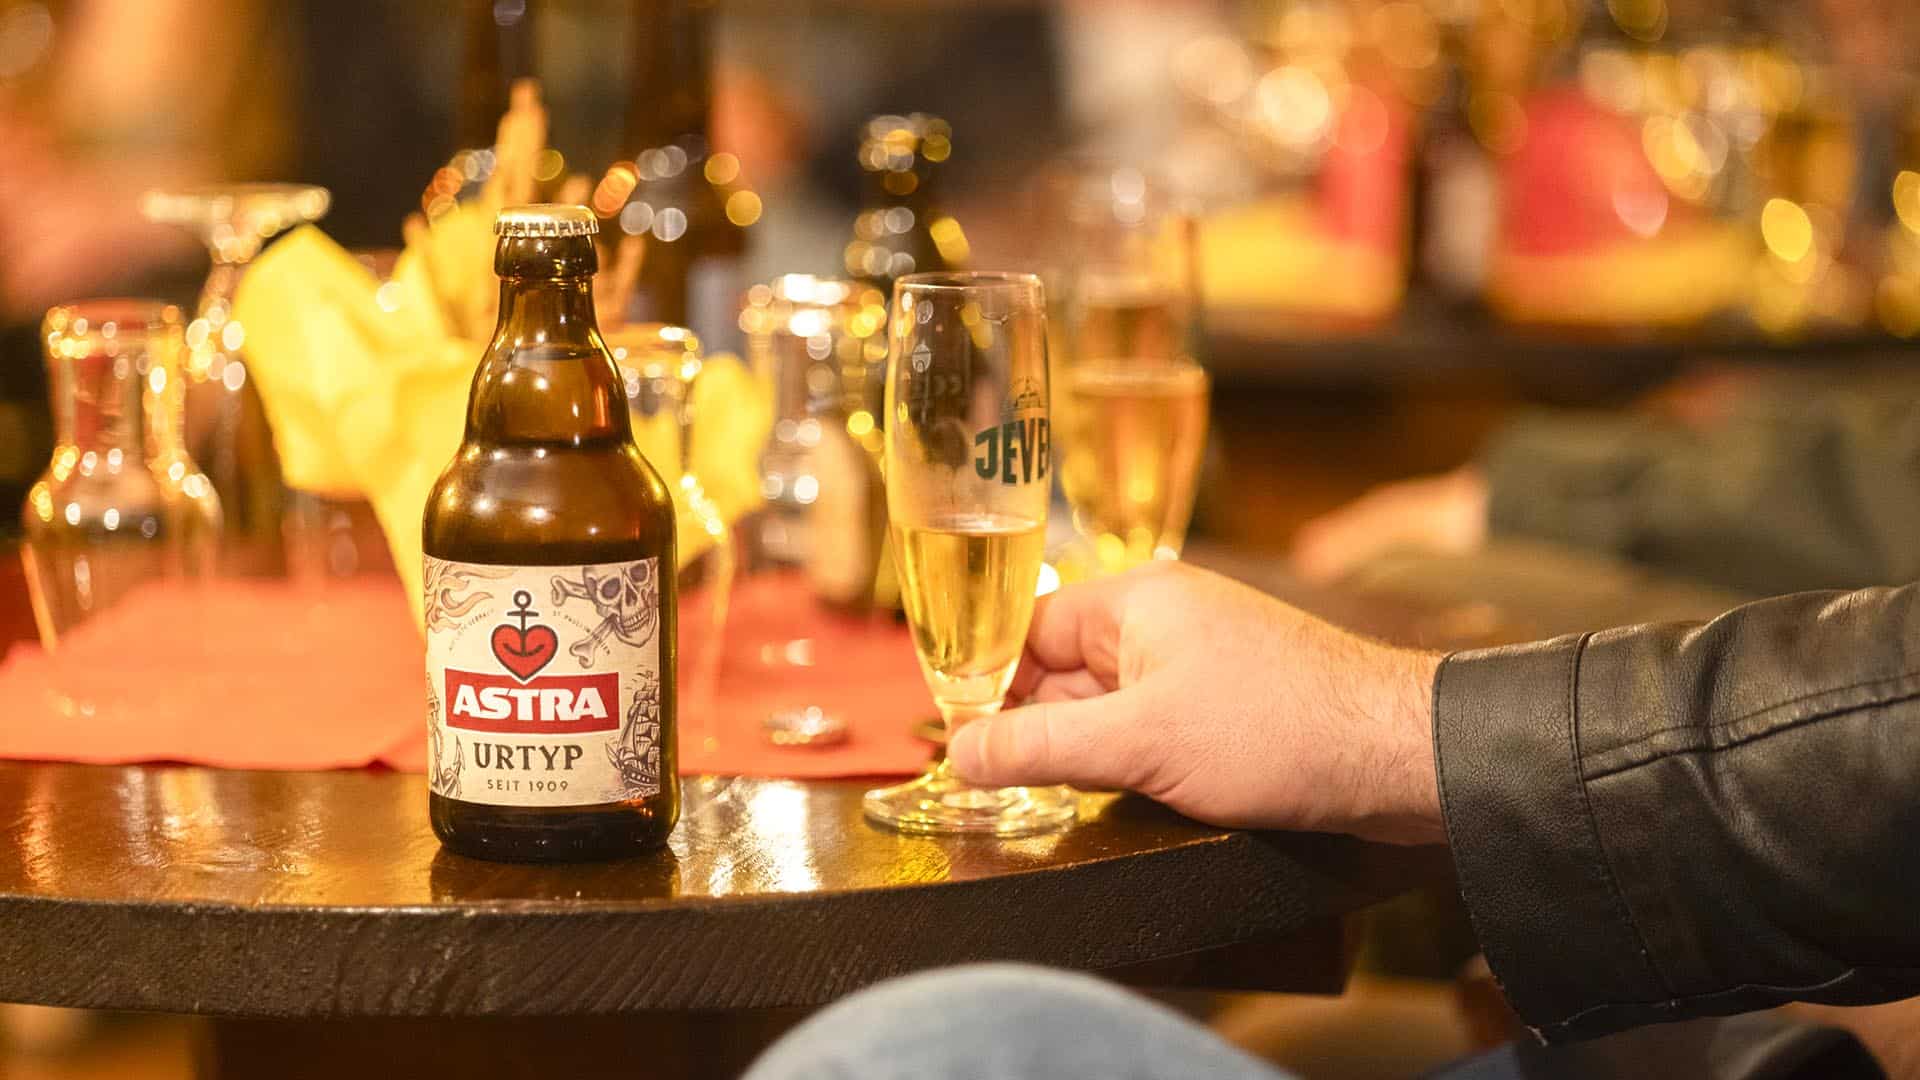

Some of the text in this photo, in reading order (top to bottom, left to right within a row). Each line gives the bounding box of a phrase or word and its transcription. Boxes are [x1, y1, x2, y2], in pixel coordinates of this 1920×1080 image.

[975, 417, 1051, 484] JEVE
[452, 684, 609, 722] ASTRA
[473, 742, 584, 771] URTYP
[487, 779, 569, 793] SEIT 1909
